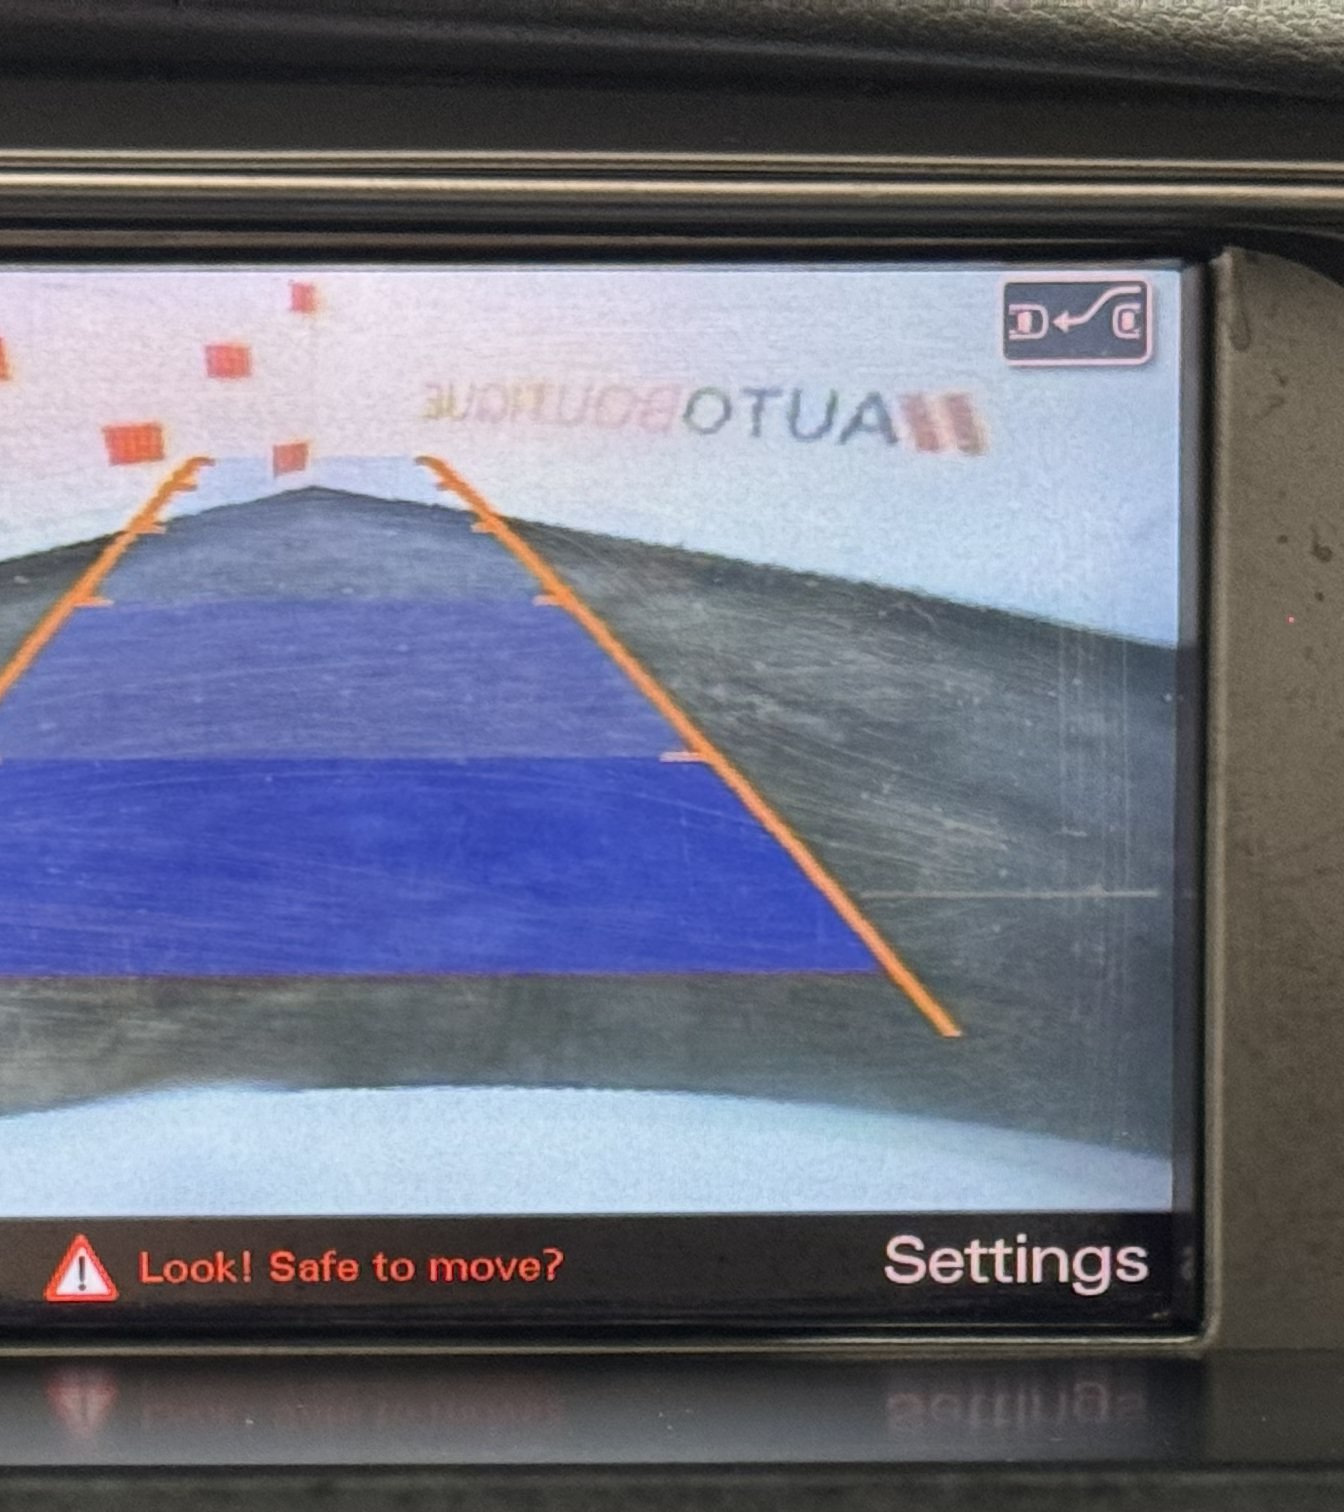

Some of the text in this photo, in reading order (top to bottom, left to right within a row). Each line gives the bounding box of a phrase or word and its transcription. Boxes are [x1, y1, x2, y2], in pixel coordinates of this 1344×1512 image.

[138, 1247, 565, 1284] Look! Safe to move?
[884, 1233, 1150, 1296] Settings
